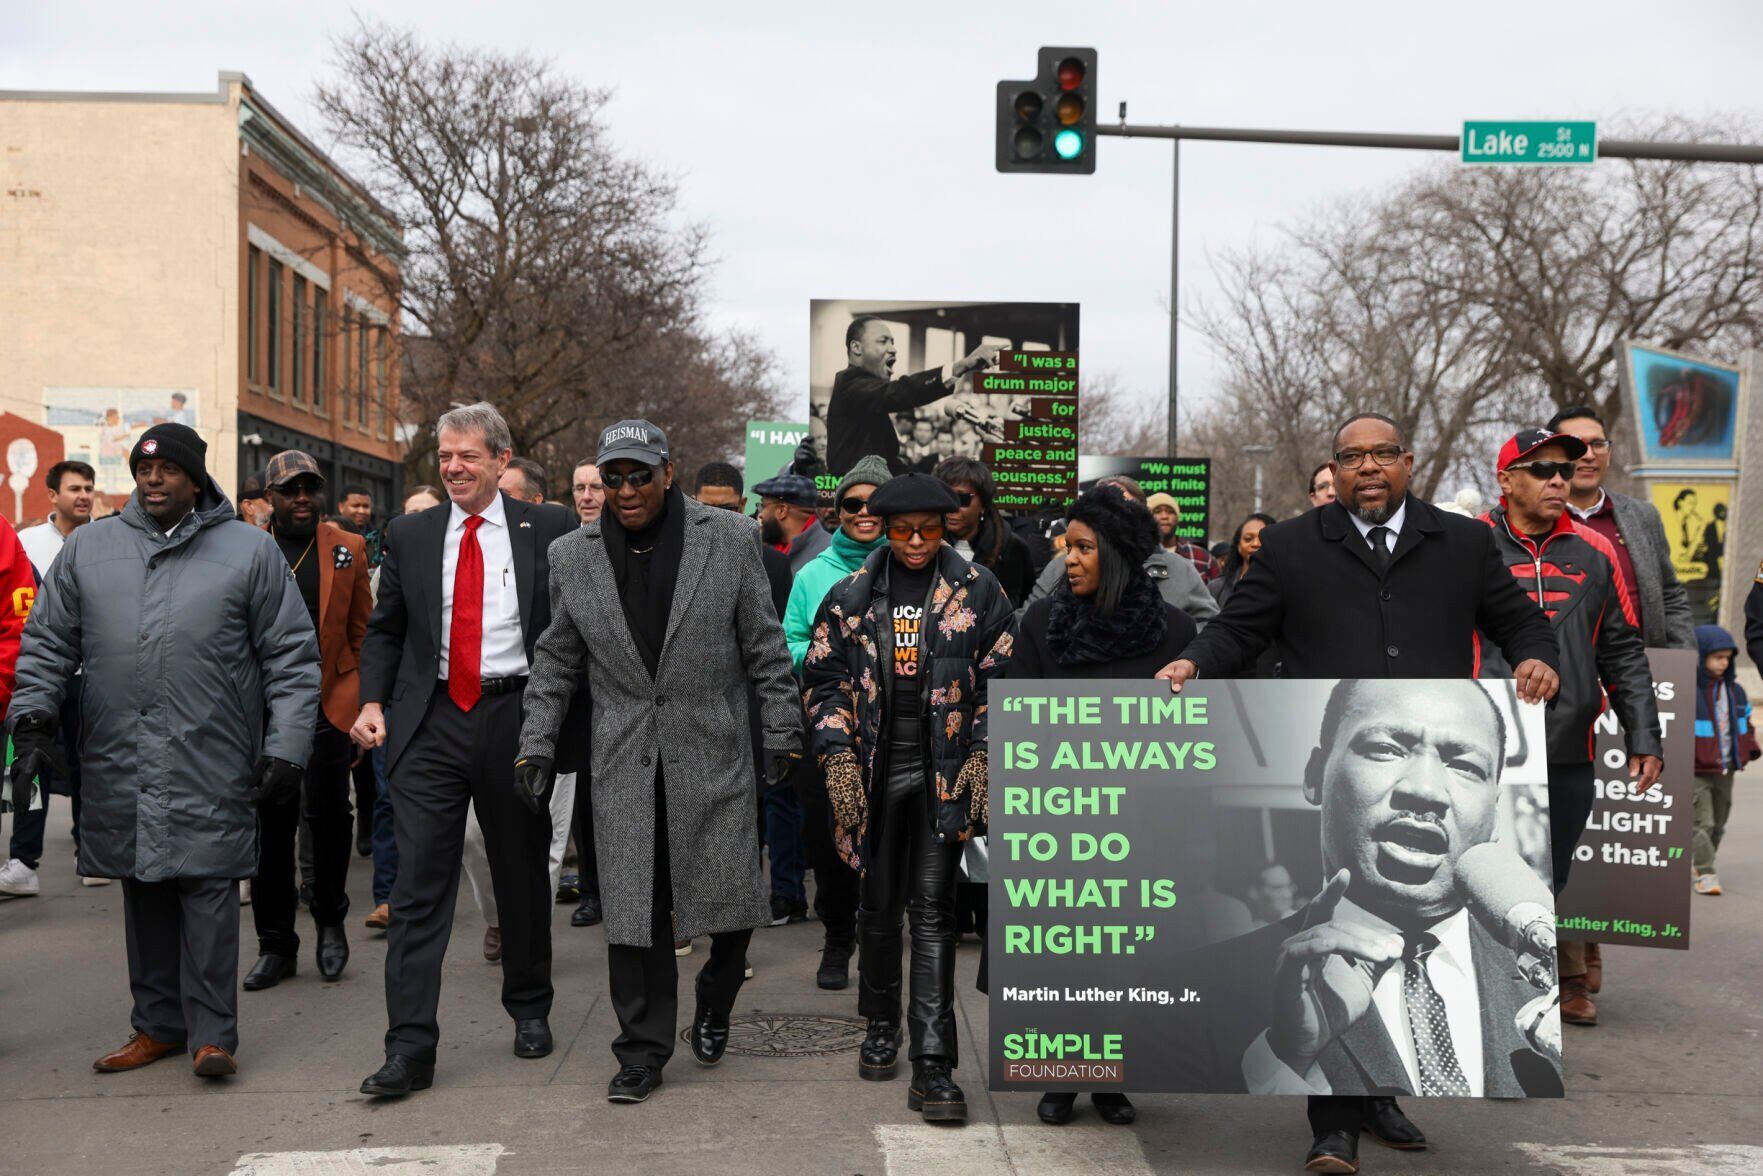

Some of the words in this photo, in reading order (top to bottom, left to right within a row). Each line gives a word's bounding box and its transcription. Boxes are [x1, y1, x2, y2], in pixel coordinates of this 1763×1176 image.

[1468, 129, 1529, 156] Lake
[1557, 126, 1571, 142] St
[1537, 142, 1575, 158] 2500
[1578, 143, 1590, 157] N
[1032, 357, 1062, 368] was
[1066, 357, 1076, 368] a
[983, 375, 1025, 390] drum
[1029, 377, 1075, 393] major
[1052, 402, 1075, 416] for
[605, 426, 648, 447] HEISMAN
[1019, 423, 1075, 440] justice,
[995, 448, 1042, 461] peace
[1046, 448, 1075, 461] and
[1173, 463, 1206, 474] must
[1138, 480, 1168, 492] cept
[1171, 479, 1206, 490] finite
[1002, 696, 1101, 725] “THE
[1113, 697, 1209, 725] TIME
[1004, 741, 1039, 770] IS
[1051, 741, 1217, 770] ALWAYS
[1004, 787, 1126, 815] RIGHT
[1585, 809, 1673, 835] LIGHT
[1003, 832, 1058, 861] TO
[1071, 832, 1130, 861] DO
[1004, 879, 1128, 908] WHAT
[1141, 879, 1177, 908] IS
[1555, 915, 1609, 932] Luther
[1613, 919, 1657, 937] King,
[1661, 923, 1682, 938] Jr.
[1004, 924, 1156, 954] RIGHT.”
[1003, 987, 1060, 1002] Martin
[1065, 987, 1124, 1002] Luther
[1128, 987, 1175, 1005] King,
[1179, 988, 1201, 1002] Jr.
[1003, 1033, 1124, 1060] SIMPLE
[1009, 1064, 1117, 1078] FOUNDATION
